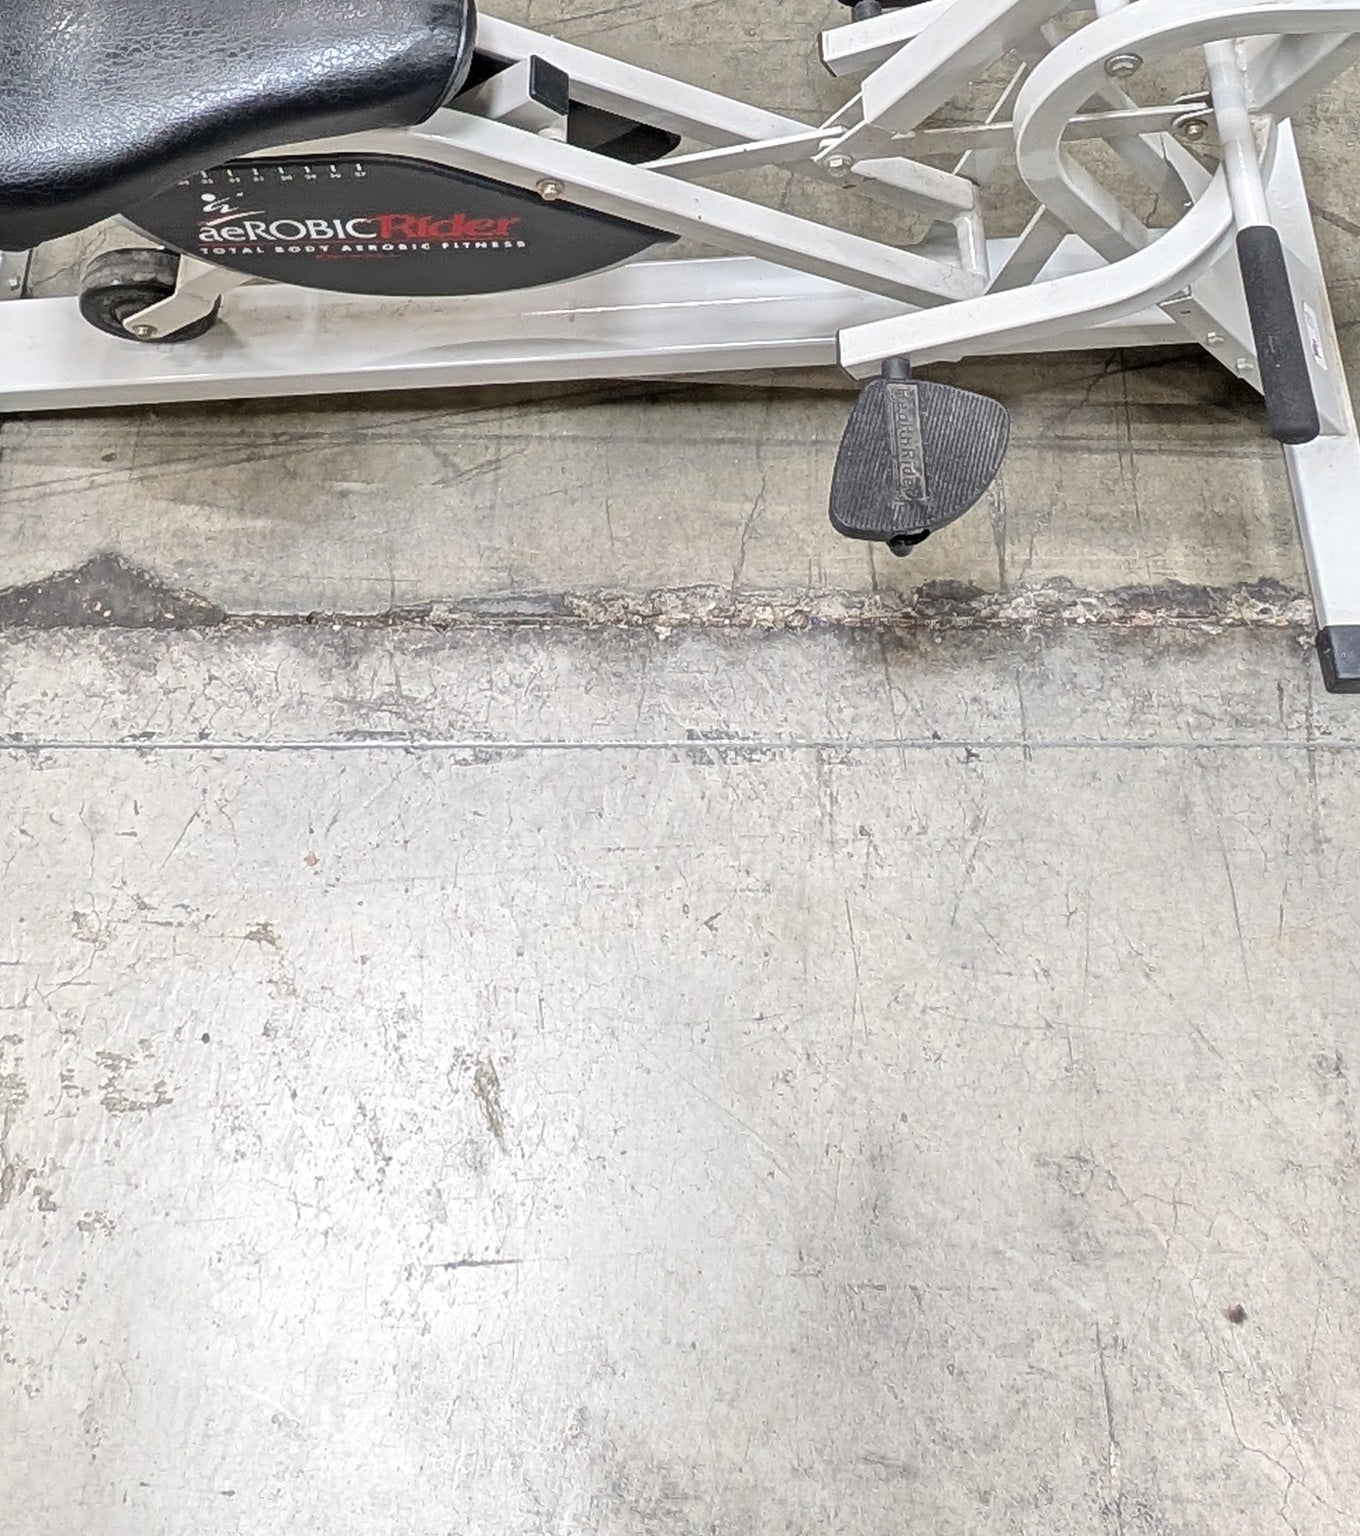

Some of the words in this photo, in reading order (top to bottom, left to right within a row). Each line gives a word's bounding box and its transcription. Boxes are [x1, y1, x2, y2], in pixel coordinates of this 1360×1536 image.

[199, 246, 265, 255] TOTAL
[275, 244, 330, 253] BODY
[341, 242, 431, 251] AEROBIC
[442, 240, 526, 249] FITNESS
